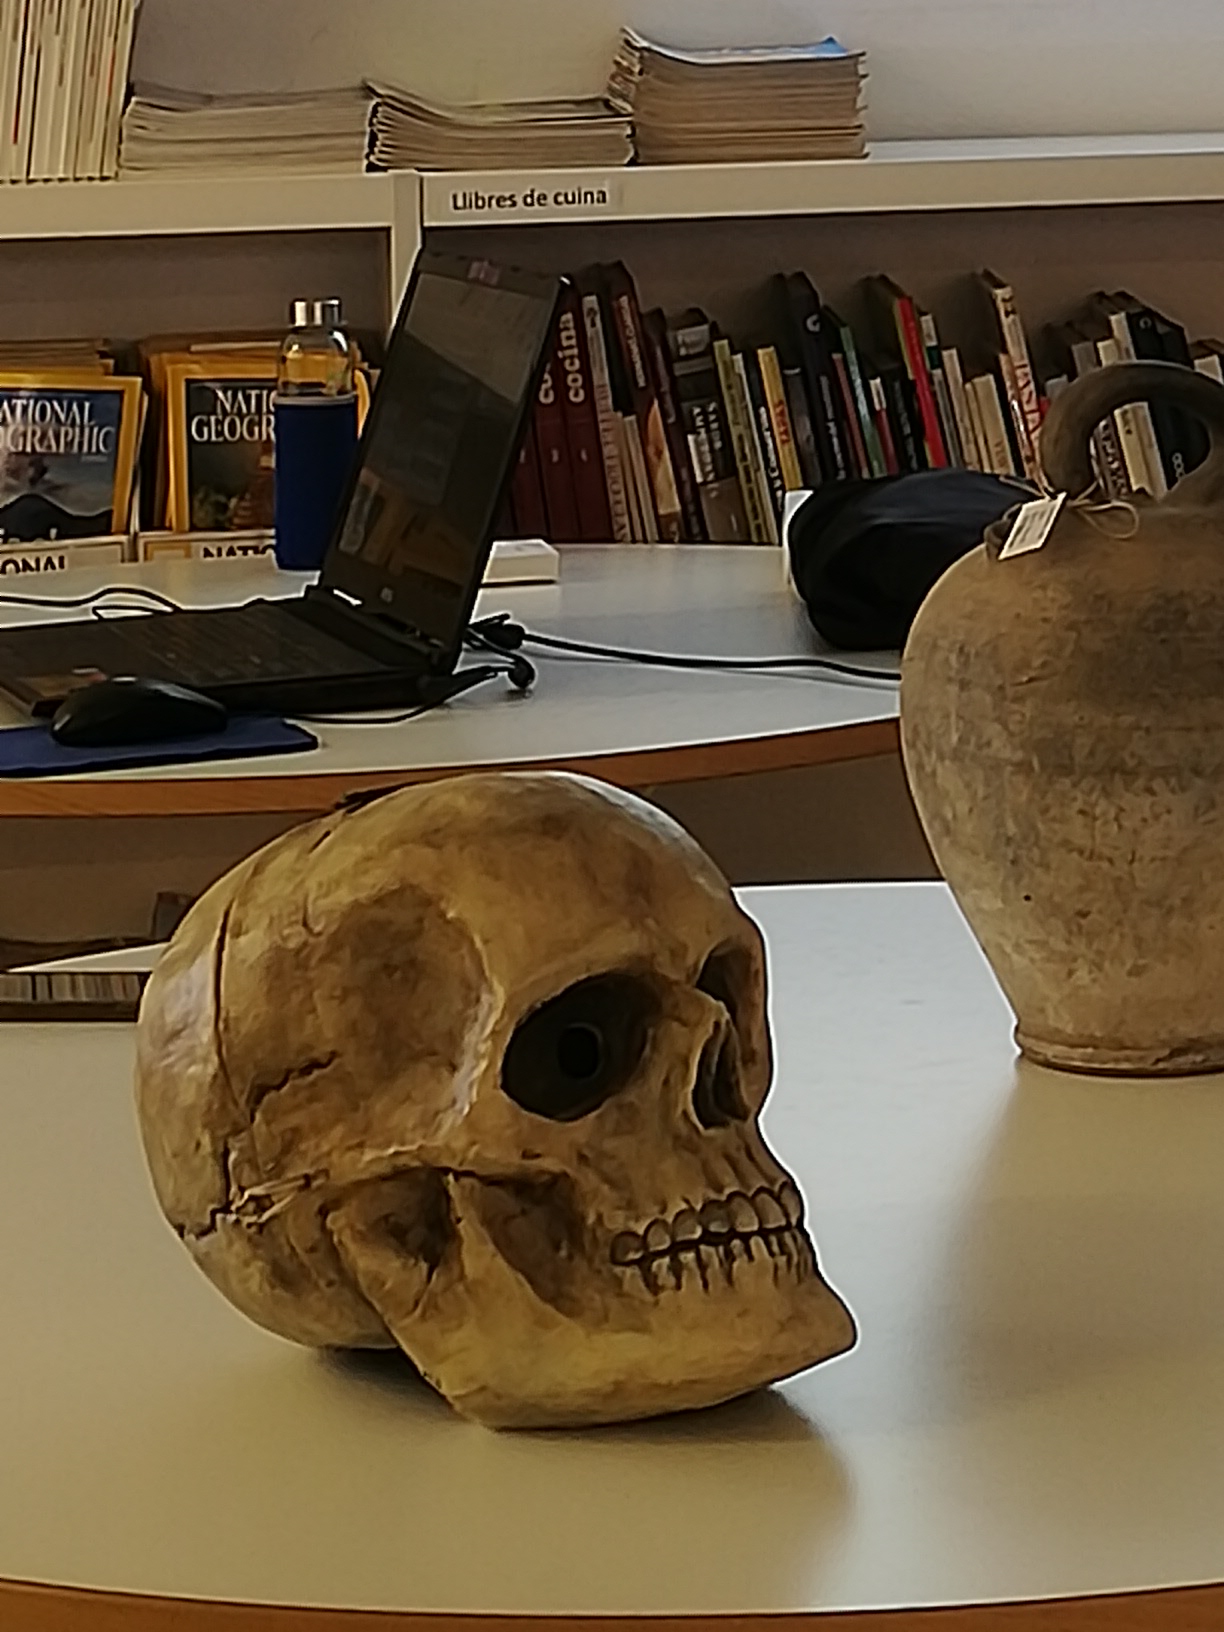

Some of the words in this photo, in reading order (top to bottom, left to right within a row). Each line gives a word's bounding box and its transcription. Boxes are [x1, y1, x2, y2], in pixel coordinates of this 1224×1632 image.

[452, 191, 518, 211] Llibres
[522, 188, 548, 208] de
[553, 186, 607, 206] cuina
[557, 311, 586, 404] cocina
[0, 425, 115, 454] GRAPHIC
